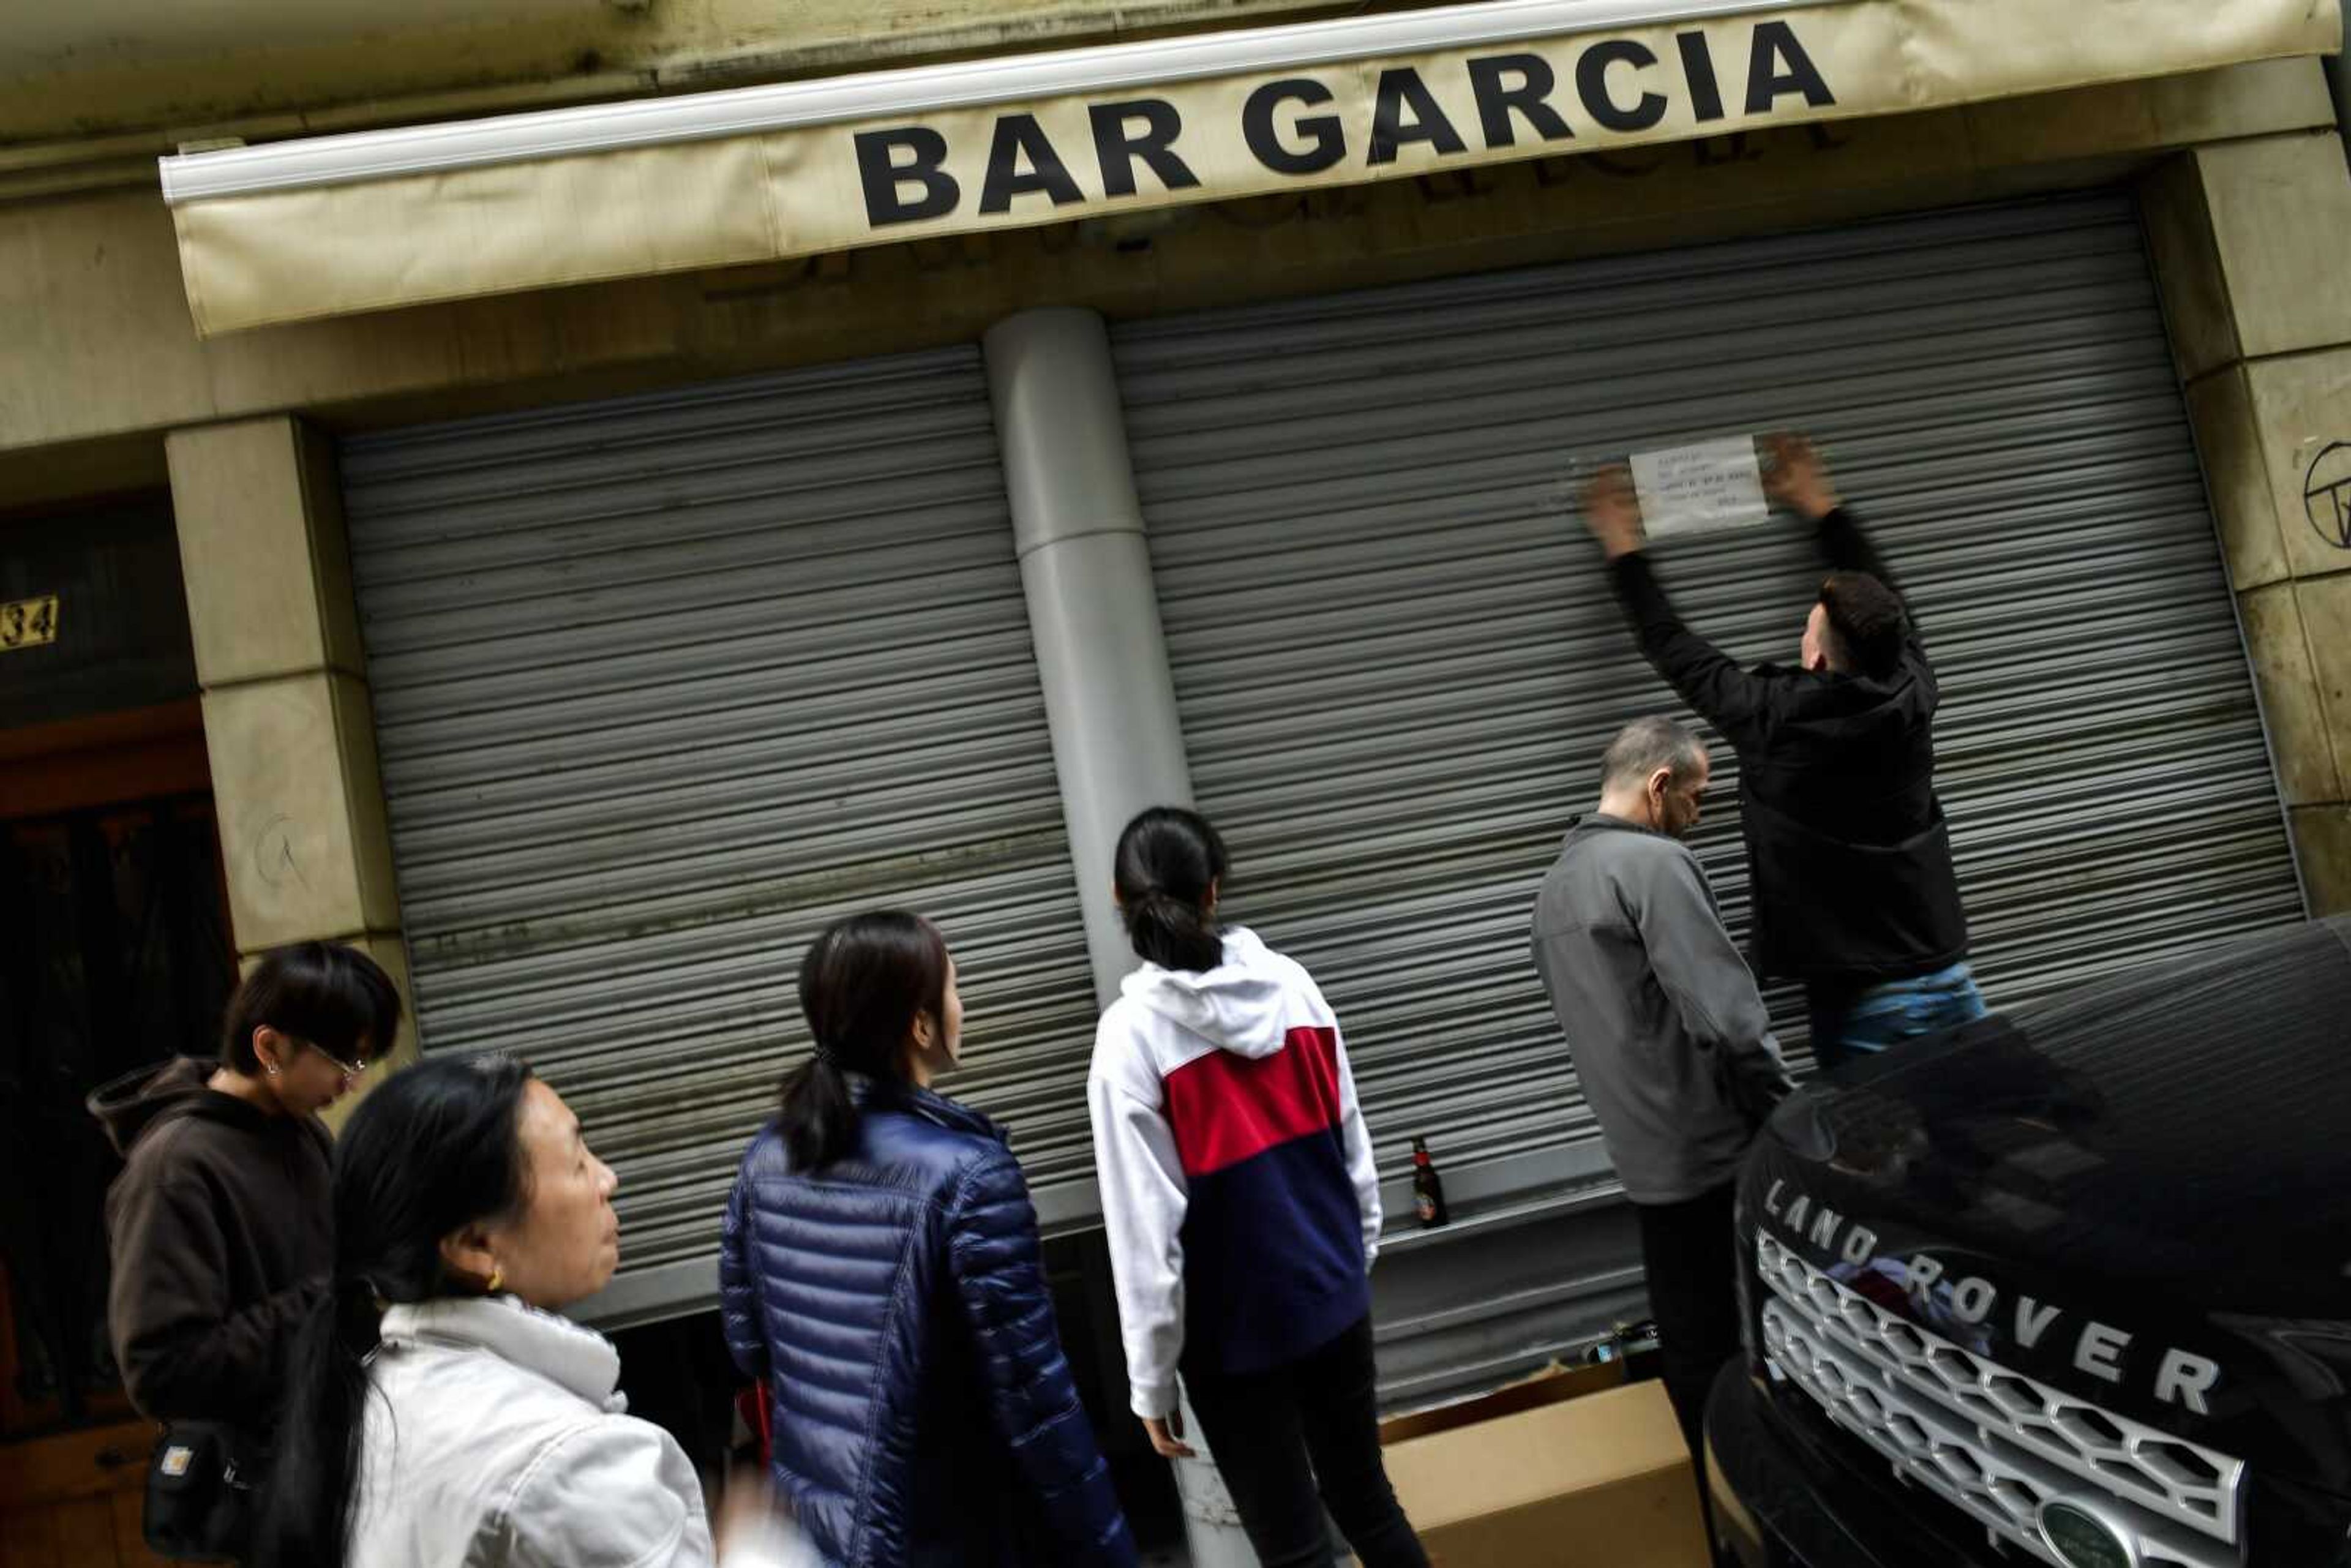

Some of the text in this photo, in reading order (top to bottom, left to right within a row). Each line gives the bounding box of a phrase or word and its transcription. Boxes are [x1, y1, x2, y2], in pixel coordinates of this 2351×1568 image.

[853, 99, 1202, 229] BAR
[1241, 20, 1836, 176] GARCIA
[1764, 1178, 2221, 1416] LAND ROVER
